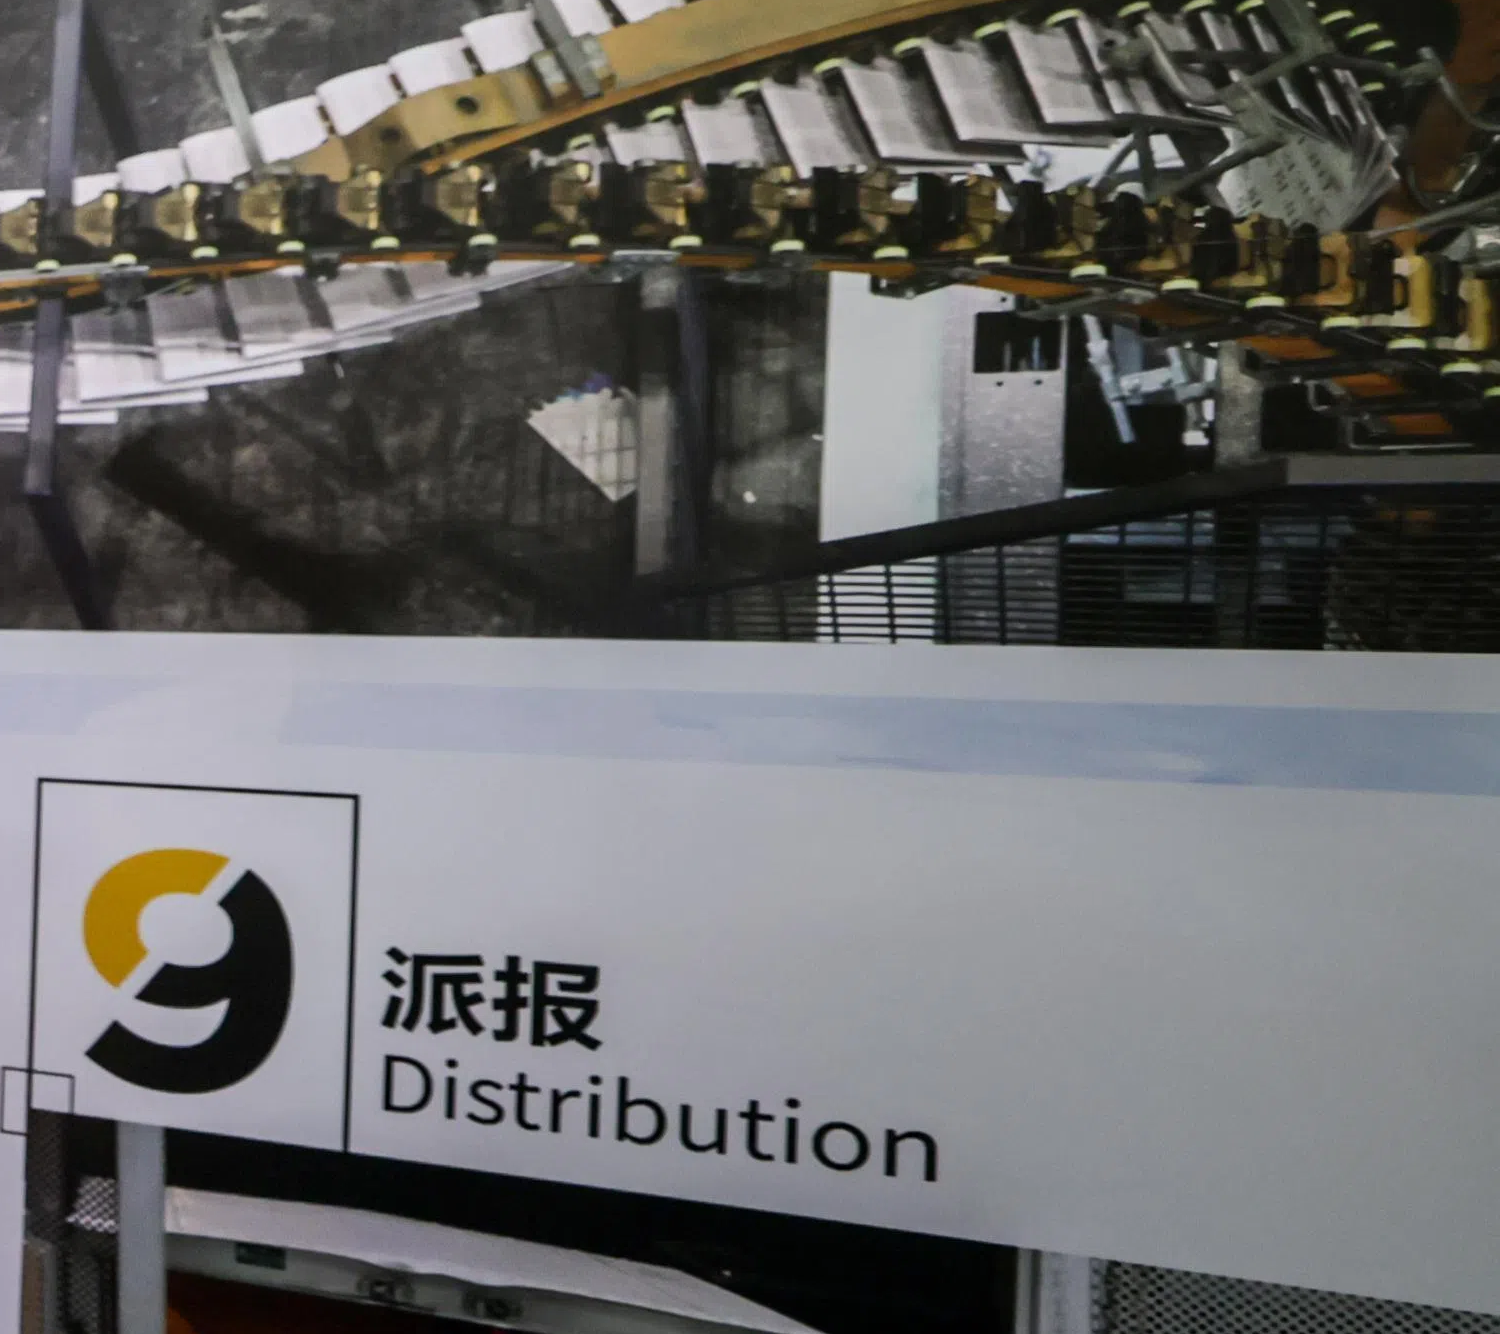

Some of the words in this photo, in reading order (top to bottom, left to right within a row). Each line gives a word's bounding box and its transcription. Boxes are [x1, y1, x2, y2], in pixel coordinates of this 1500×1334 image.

[82, 847, 296, 1096] 9
[380, 946, 604, 1052] 派报
[381, 1053, 940, 1184] Distribution
